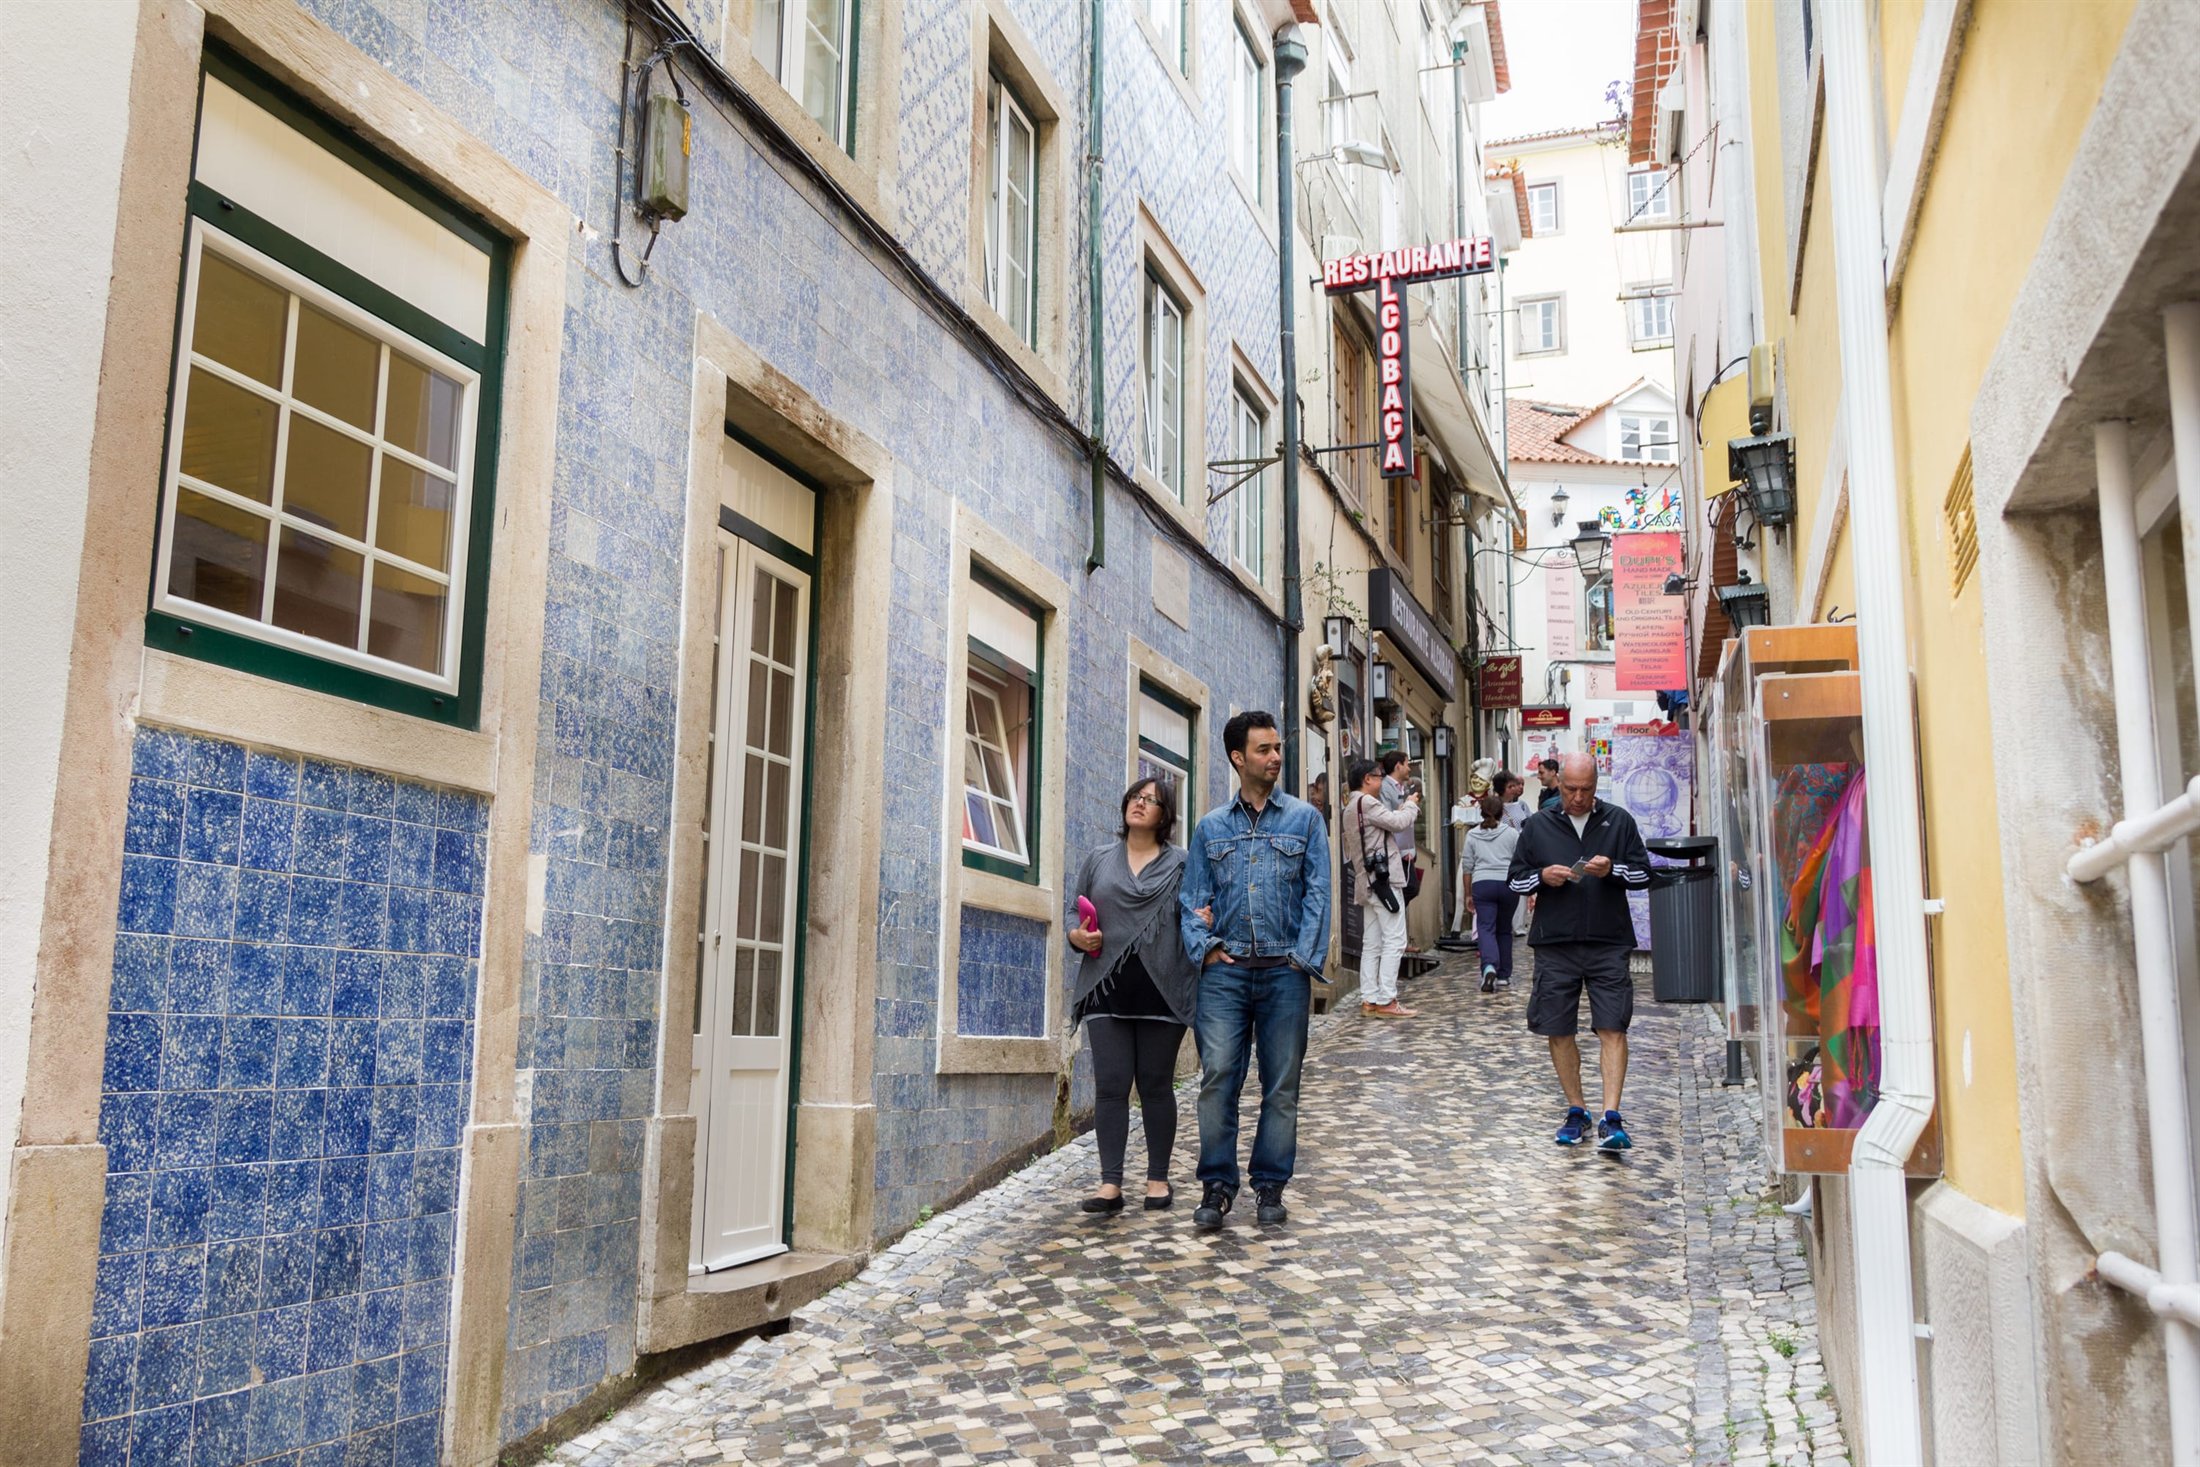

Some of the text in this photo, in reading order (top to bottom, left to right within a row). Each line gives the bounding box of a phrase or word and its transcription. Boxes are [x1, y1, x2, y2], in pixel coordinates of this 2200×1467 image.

[1323, 236, 1492, 288] RESTAURANTE
[1644, 513, 1681, 527] CASA
[1626, 725, 1650, 734] floor
